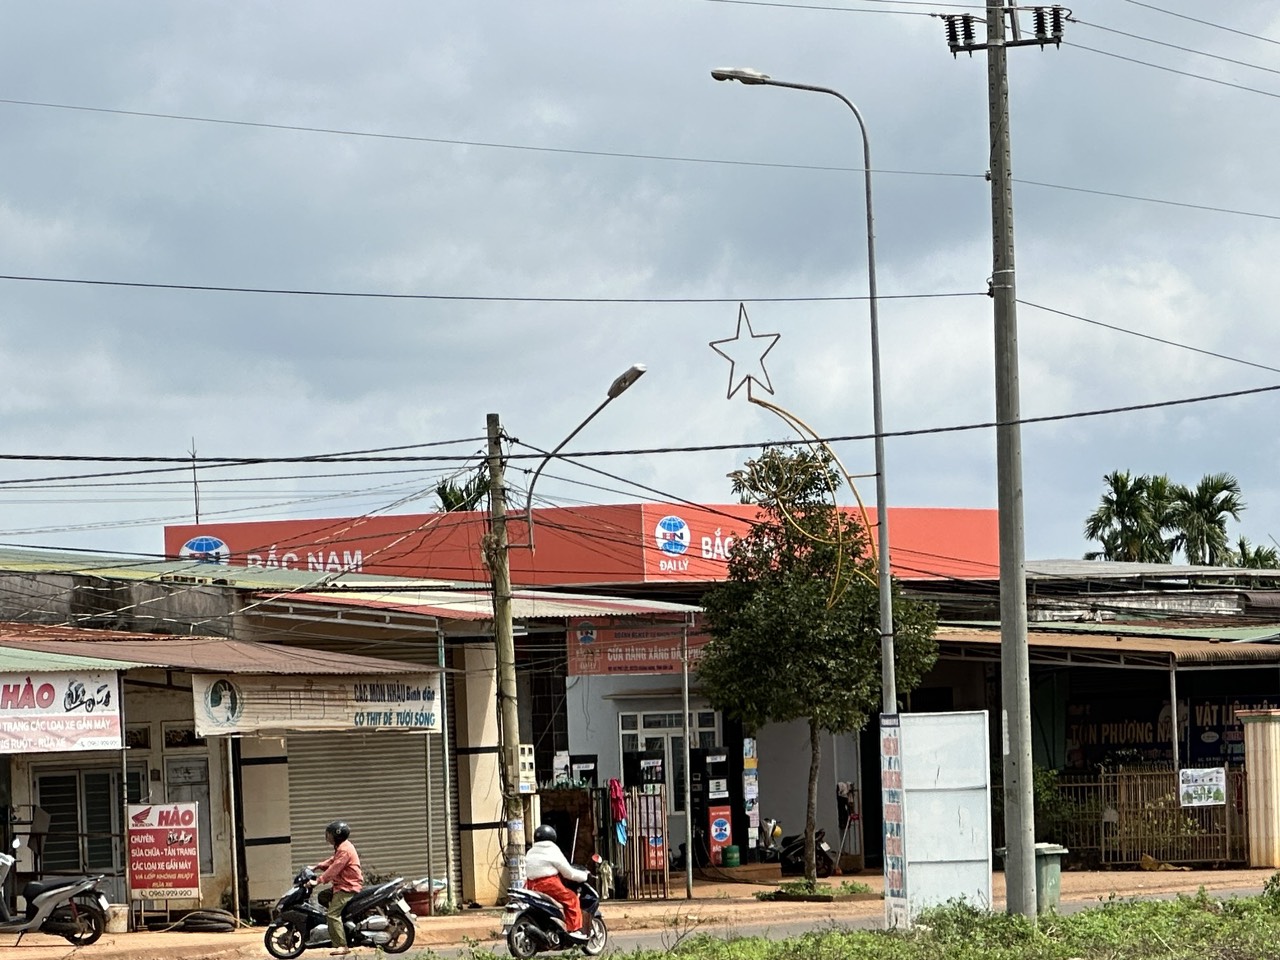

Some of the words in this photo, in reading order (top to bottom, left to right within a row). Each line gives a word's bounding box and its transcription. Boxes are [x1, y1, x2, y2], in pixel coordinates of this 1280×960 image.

[308, 549, 362, 573] NAM
[660, 560, 677, 573] ĐẠI
[679, 558, 689, 571] LÝ
[1222, 699, 1249, 731] LIỆ
[4, 721, 30, 732] TRANG
[30, 718, 46, 731] CÁC
[47, 720, 64, 733] LOẠI
[65, 721, 76, 730] XE
[76, 717, 94, 730] GẮN
[94, 718, 111, 729] MÁY
[177, 847, 196, 856] TRANG
[132, 861, 144, 870] CÁC
[157, 862, 165, 870] XE
[179, 860, 192, 870] MÁY
